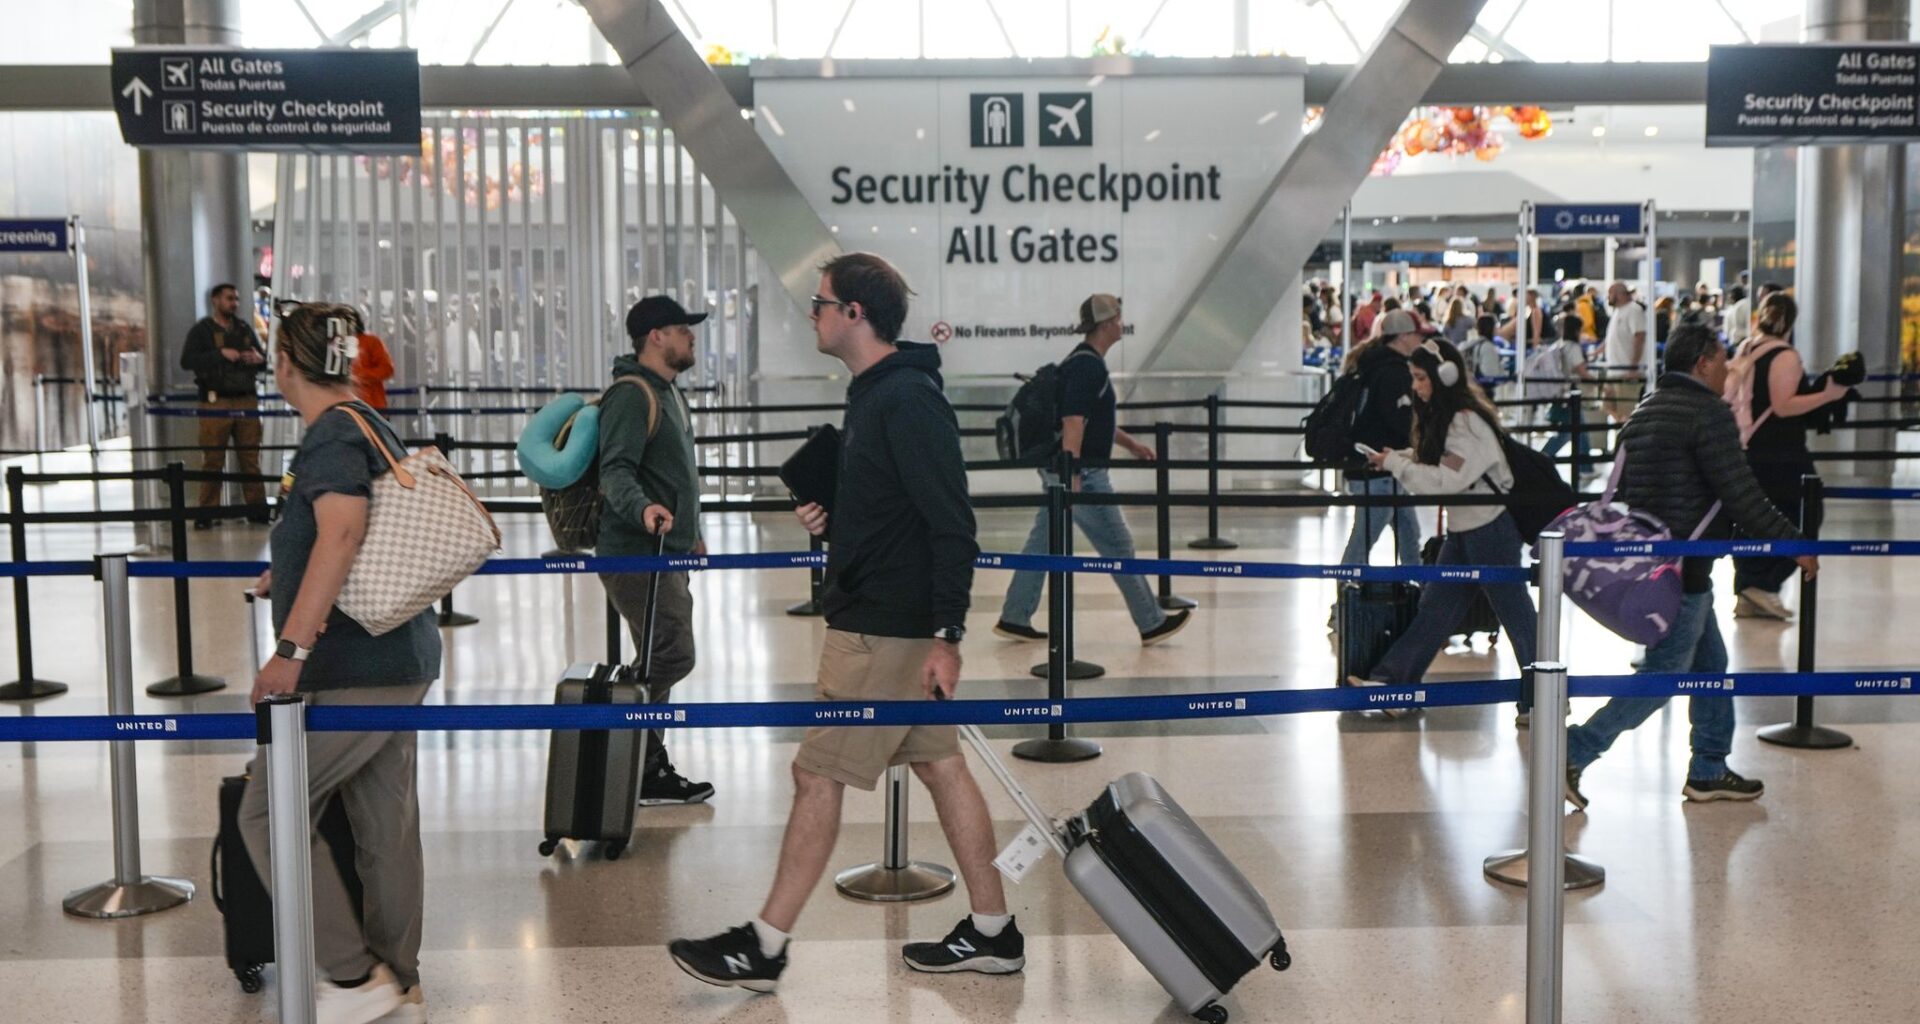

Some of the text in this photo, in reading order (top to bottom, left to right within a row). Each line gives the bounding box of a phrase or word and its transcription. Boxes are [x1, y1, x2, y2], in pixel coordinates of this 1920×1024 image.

[200, 57, 284, 75] All Gates
[1837, 52, 1916, 70] All Gates
[200, 78, 286, 91] Todas Puertas
[1835, 73, 1915, 85] Todas Puertas
[1744, 93, 1914, 114] Security Checkpoint
[202, 100, 385, 121] Security Checkpoint
[1737, 113, 1915, 129] Puesto de control de seguridad
[202, 120, 391, 136] Puesto de control de seguridad
[830, 163, 1222, 214] Security Checkpoint
[1578, 214, 1621, 226] CLEAR
[946, 224, 1119, 264] All Gates
[954, 324, 1074, 339] No Firearms Beyond
[1677, 681, 1722, 689] UNITED
[1855, 680, 1899, 688] UNITED
[1369, 693, 1413, 702] UNITED
[1004, 707, 1049, 716] UNITED
[1188, 701, 1233, 710] UNITED
[815, 710, 861, 719] UNITED
[116, 722, 163, 730] UNITED
